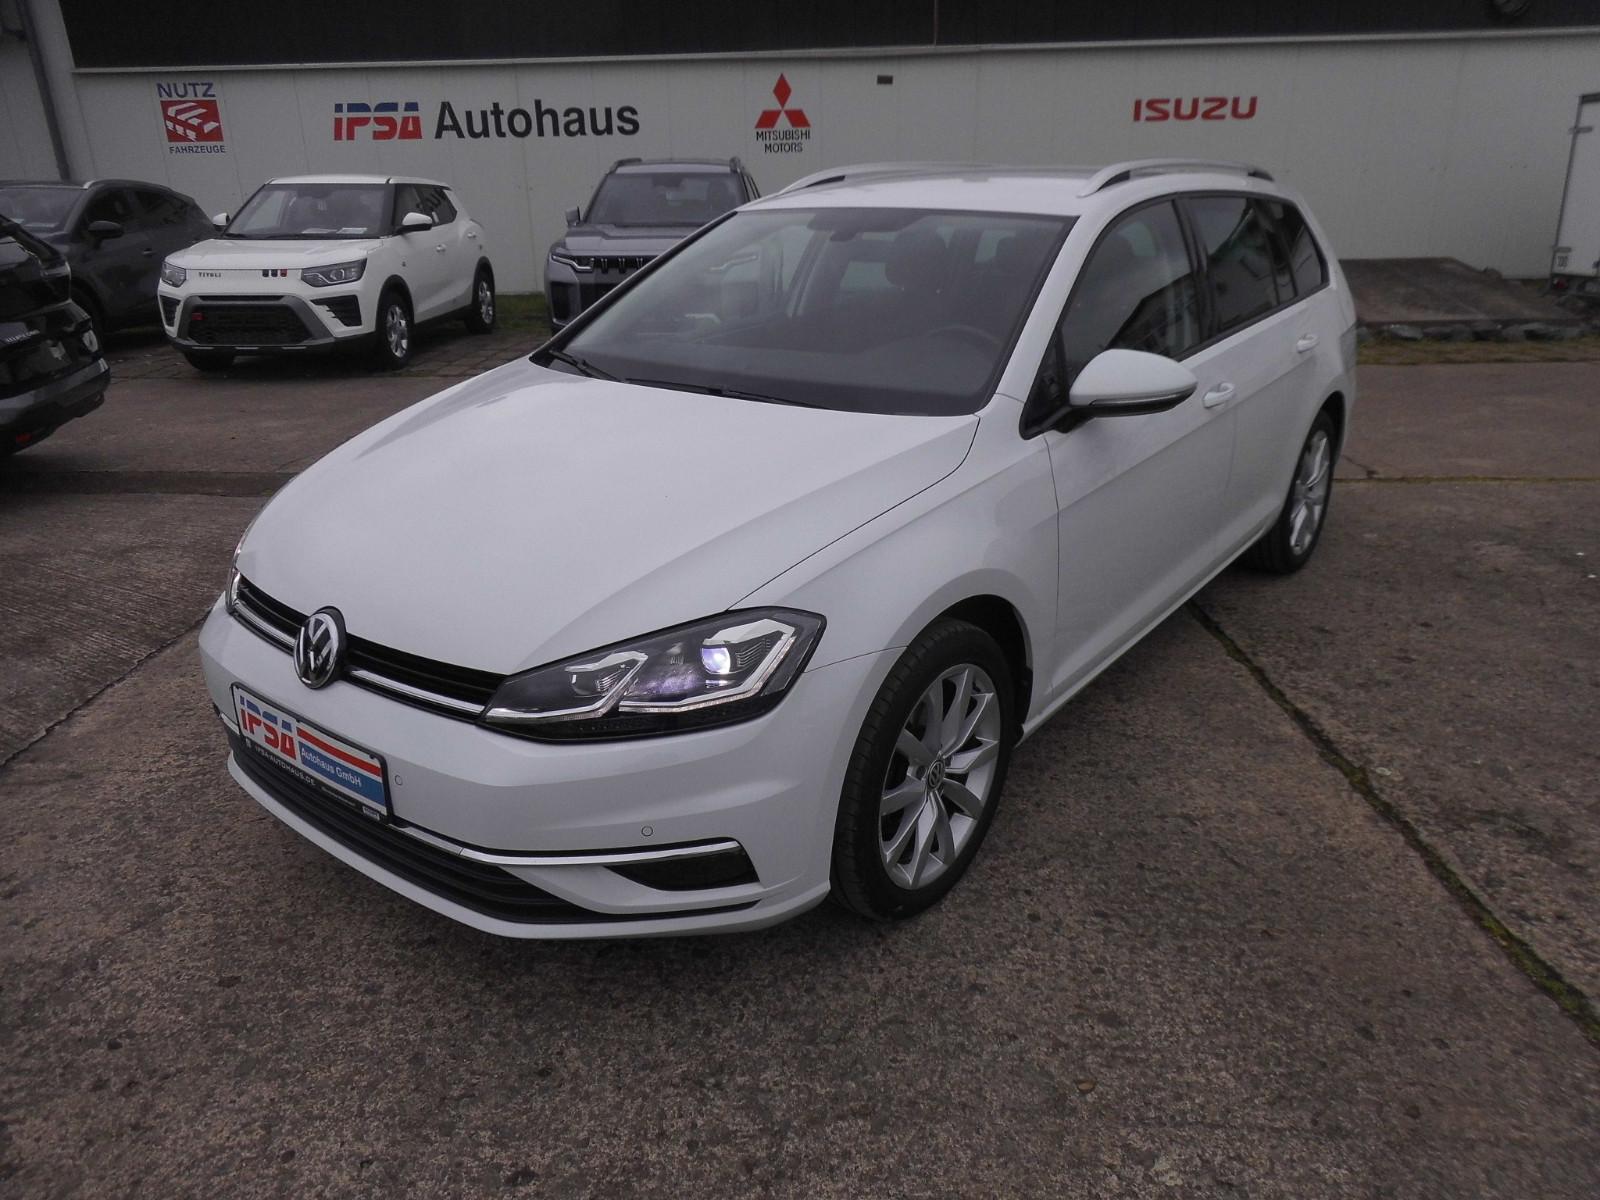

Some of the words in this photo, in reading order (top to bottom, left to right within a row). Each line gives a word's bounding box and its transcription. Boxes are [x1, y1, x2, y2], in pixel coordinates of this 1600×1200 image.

[156, 82, 216, 98] NUTZ
[1133, 96, 1258, 122] ISUZU
[333, 102, 422, 141] IPSA
[434, 99, 640, 139] Autohaus
[756, 129, 811, 141] MITSUBISHI
[169, 145, 227, 154] FAHRZEUGE
[764, 142, 803, 153] MOTORS
[239, 694, 297, 761] IPSA
[301, 747, 336, 775] Autohaus
[335, 766, 363, 787] GmbH
